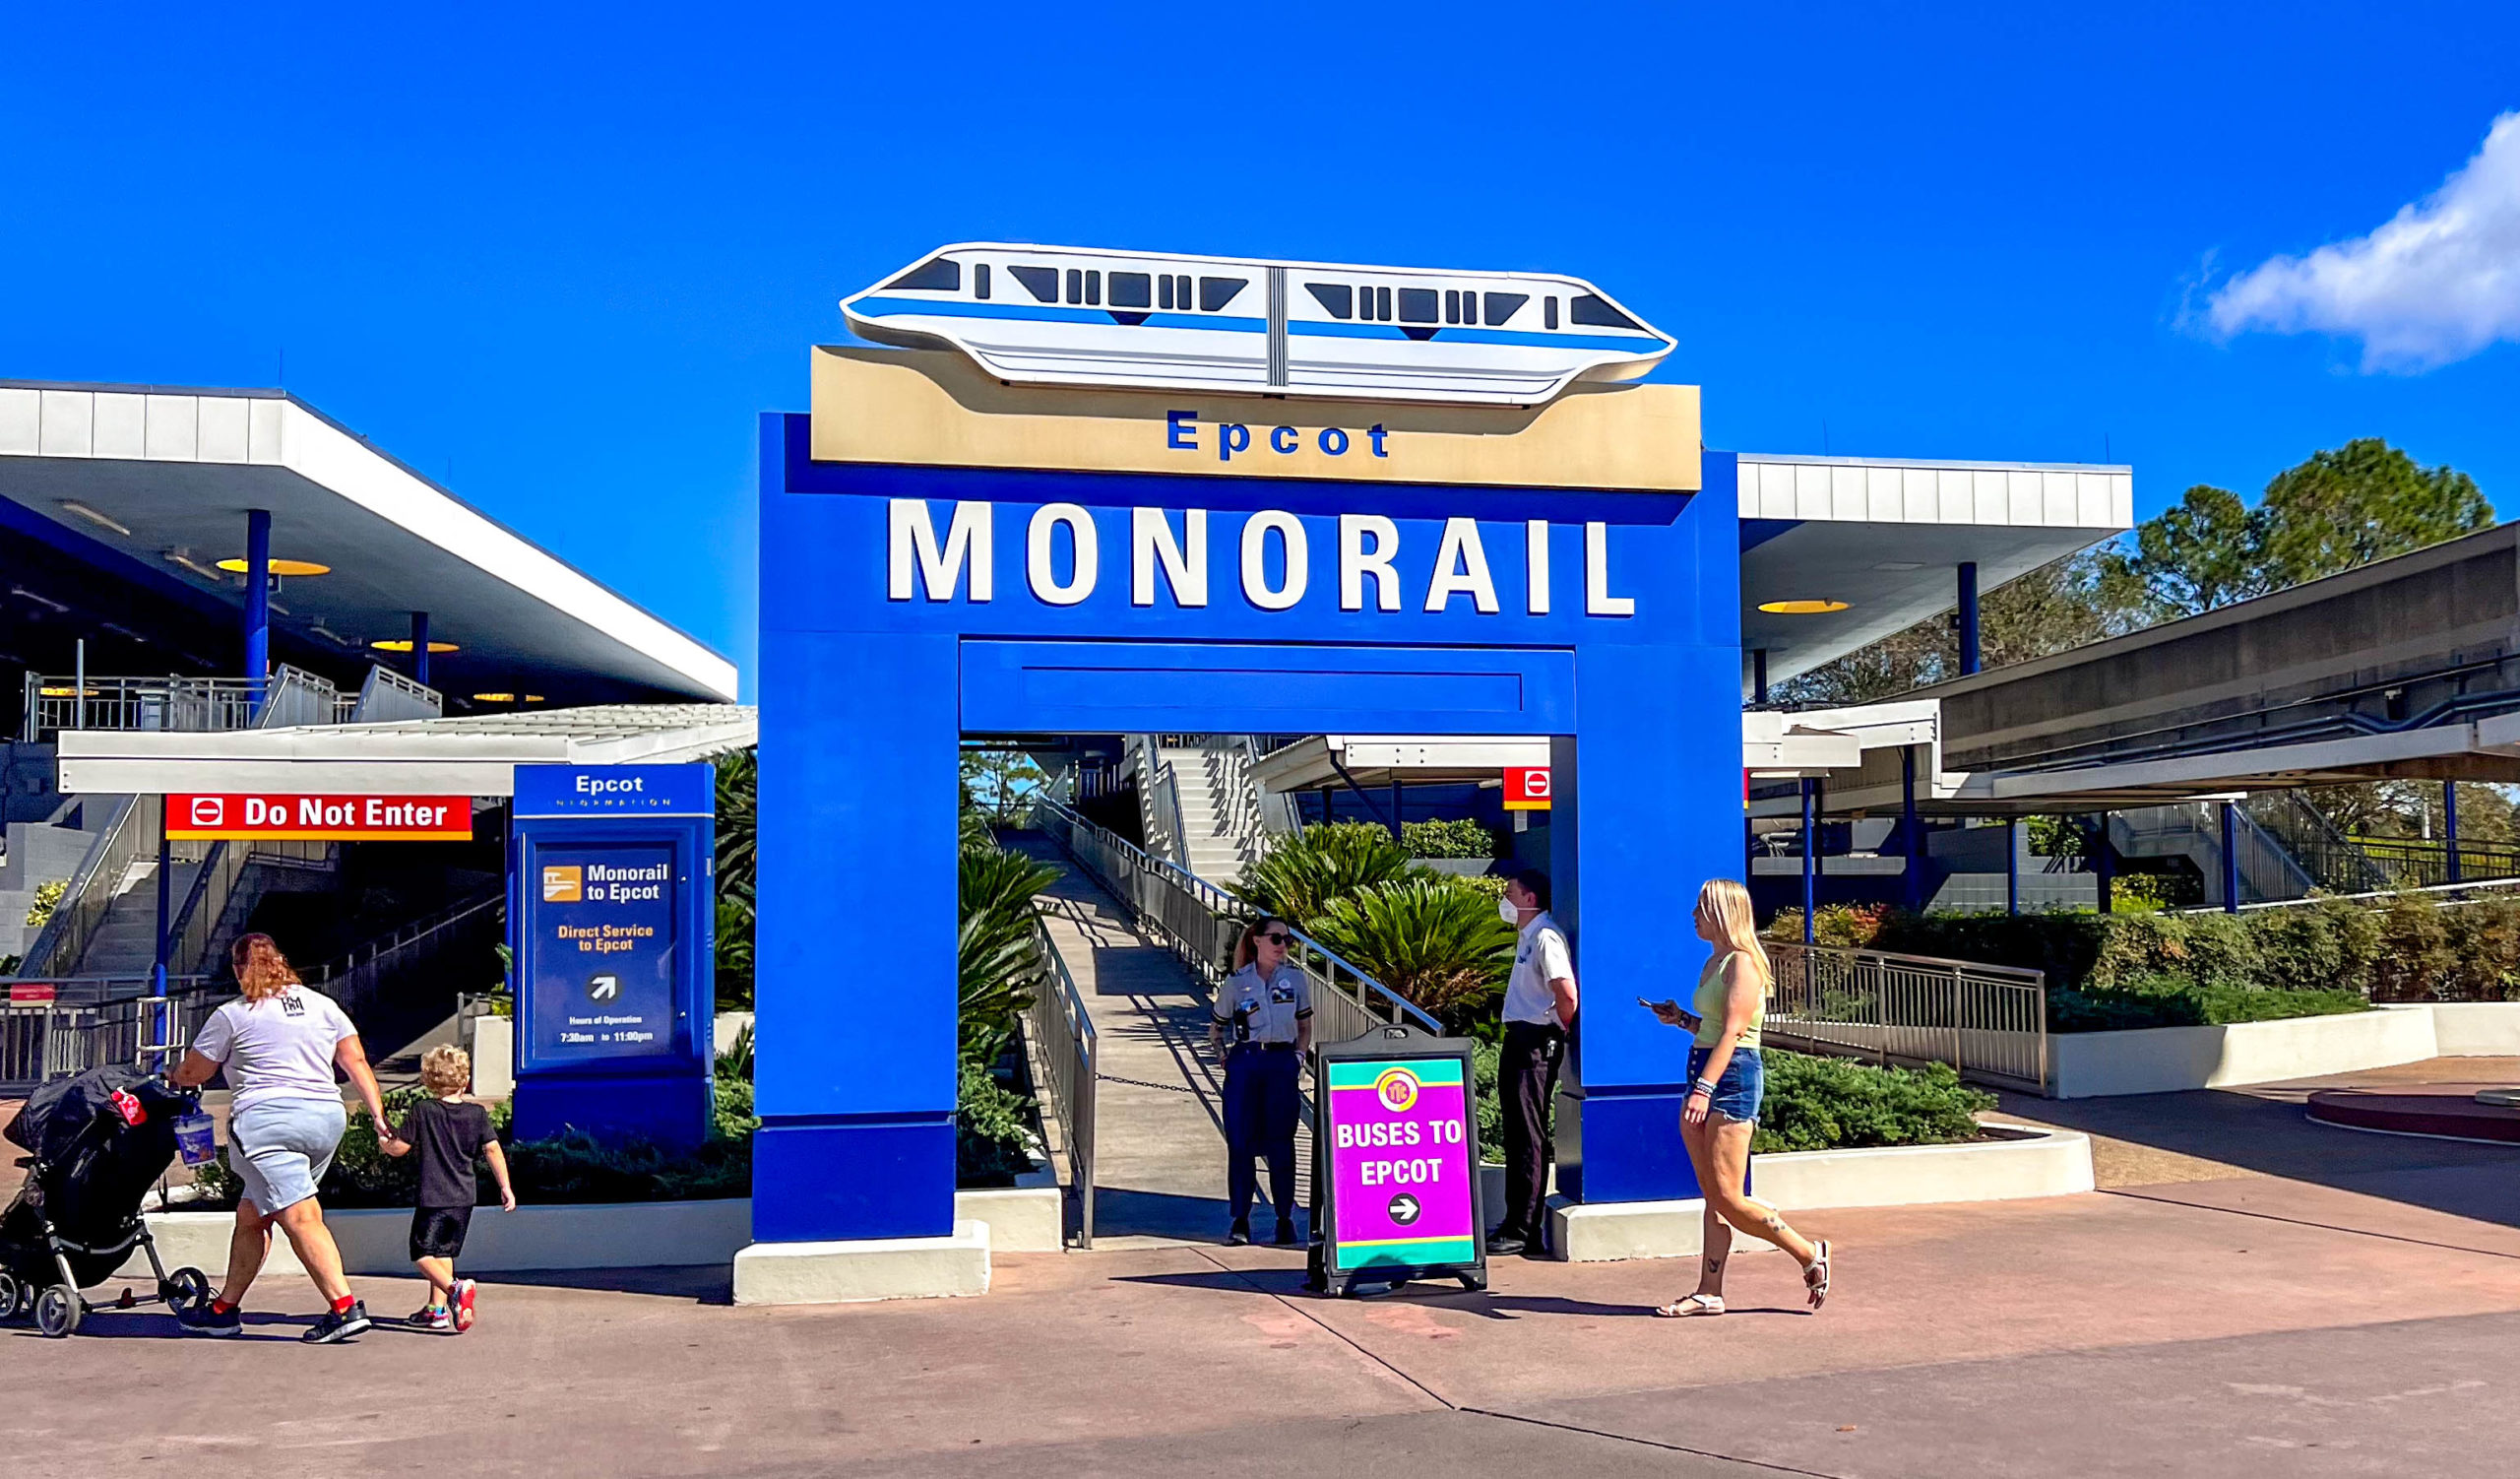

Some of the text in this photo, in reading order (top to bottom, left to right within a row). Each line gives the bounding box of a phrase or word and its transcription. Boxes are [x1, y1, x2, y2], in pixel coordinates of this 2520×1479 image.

[1166, 409, 1389, 462] Epcot
[887, 497, 1636, 617] MONORAIL
[576, 775, 644, 796] Epcot
[245, 798, 448, 826] Do Not Enter
[547, 799, 670, 807] NORMAION
[588, 864, 667, 881] Monorail
[588, 883, 660, 904] to Epcot
[558, 924, 654, 938] Direct Service
[579, 938, 633, 954] to Epcot
[569, 1015, 643, 1026] Hours of Operation
[560, 1032, 595, 1043] 7:30am
[613, 1031, 654, 1043] 11:00pm
[1337, 1119, 1463, 1148] BUSES TO
[1360, 1158, 1443, 1186] EPCOT
